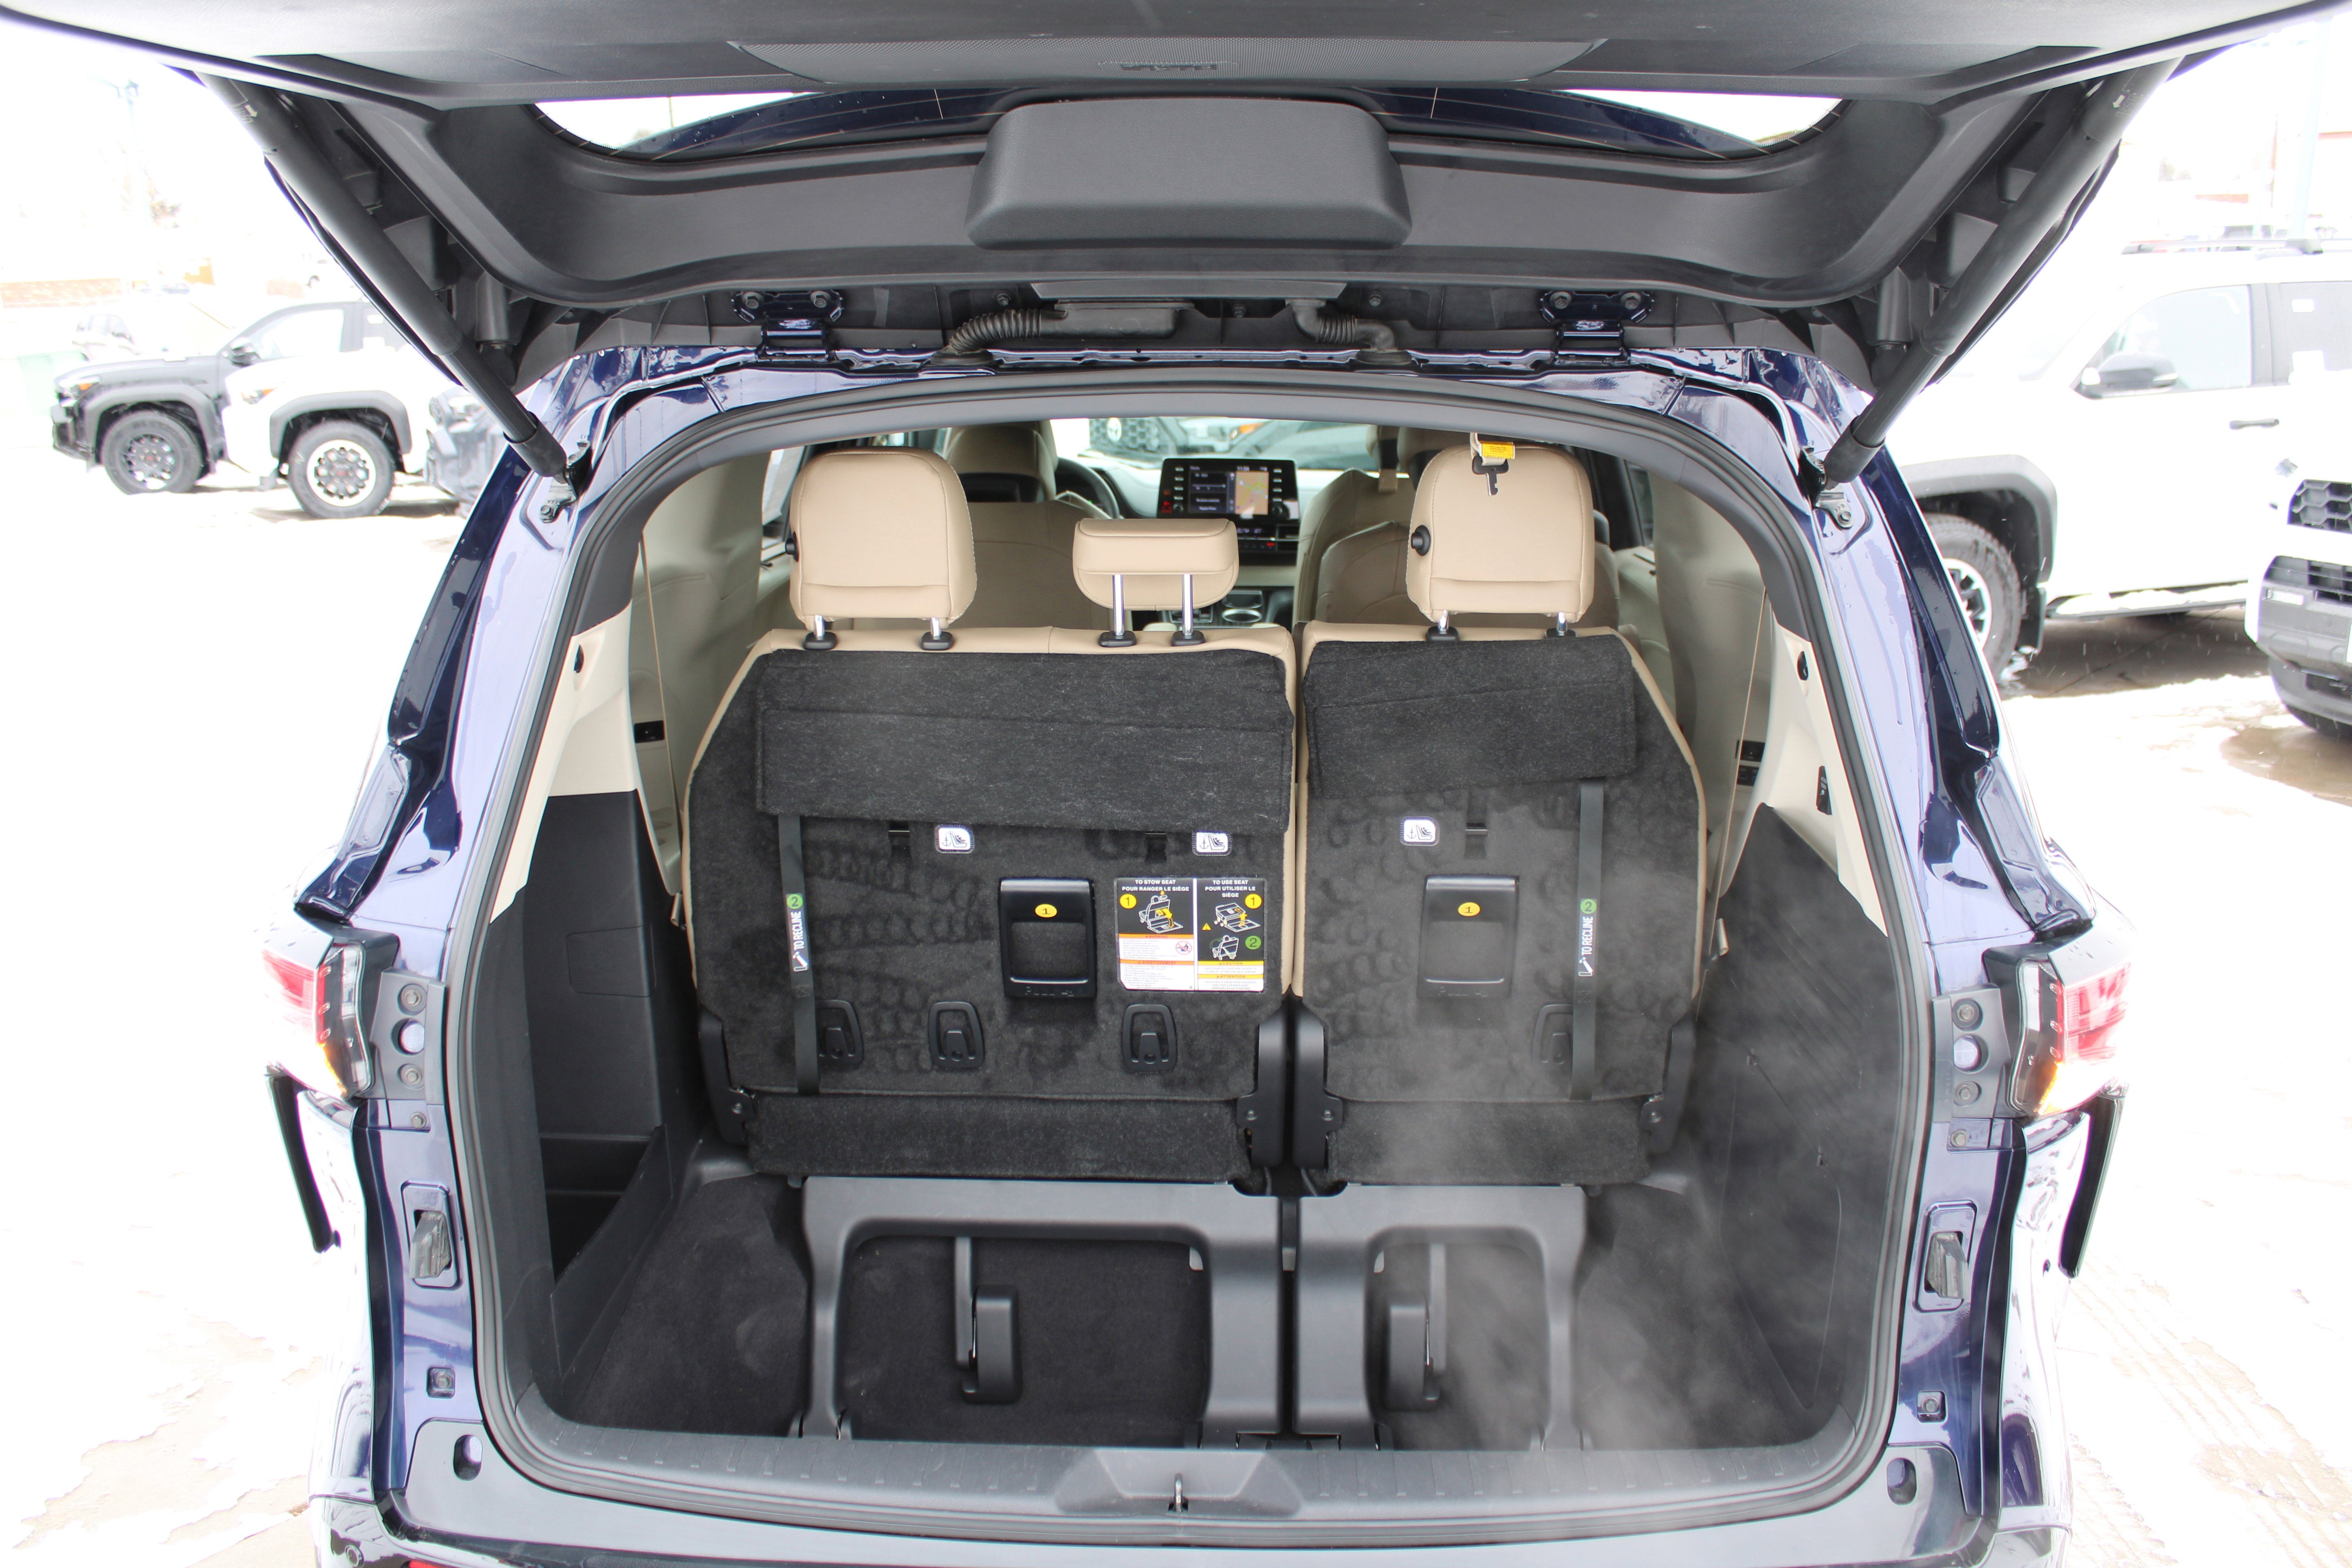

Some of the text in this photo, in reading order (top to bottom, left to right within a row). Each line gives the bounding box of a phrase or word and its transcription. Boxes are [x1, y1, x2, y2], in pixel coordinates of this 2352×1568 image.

[791, 896, 798, 907] 2
[1125, 897, 1129, 906] 1
[1250, 897, 1255, 906] 1
[1584, 901, 1592, 912] 2
[791, 911, 804, 951] TO RECLINE
[1581, 916, 1593, 956] TO RECLINE
[1249, 938, 1257, 947] 2
